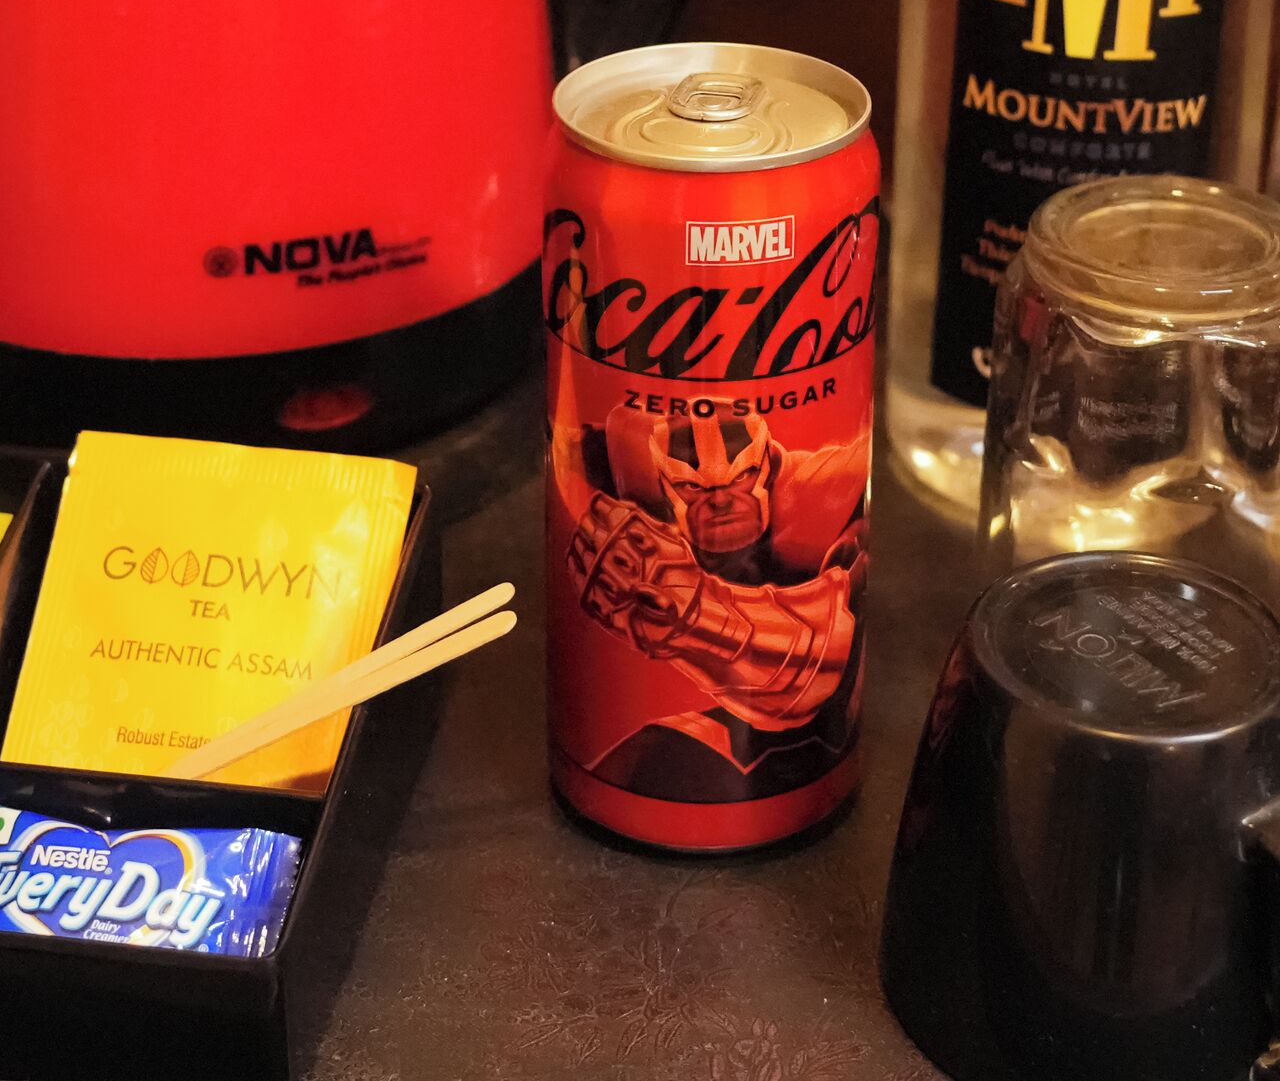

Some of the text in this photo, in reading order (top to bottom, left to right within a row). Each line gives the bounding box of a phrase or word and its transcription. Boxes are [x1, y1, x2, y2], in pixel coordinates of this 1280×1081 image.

[243, 228, 377, 275] NOVA
[689, 221, 791, 262] MARVEL
[623, 377, 837, 418] ZERO SUGAR
[102, 545, 342, 602] GOODWYN
[189, 599, 232, 621] TEA
[89, 639, 313, 681] AUTHENTIC ASSAM
[116, 726, 165, 747] Robust
[90, 919, 121, 933] Dairy
